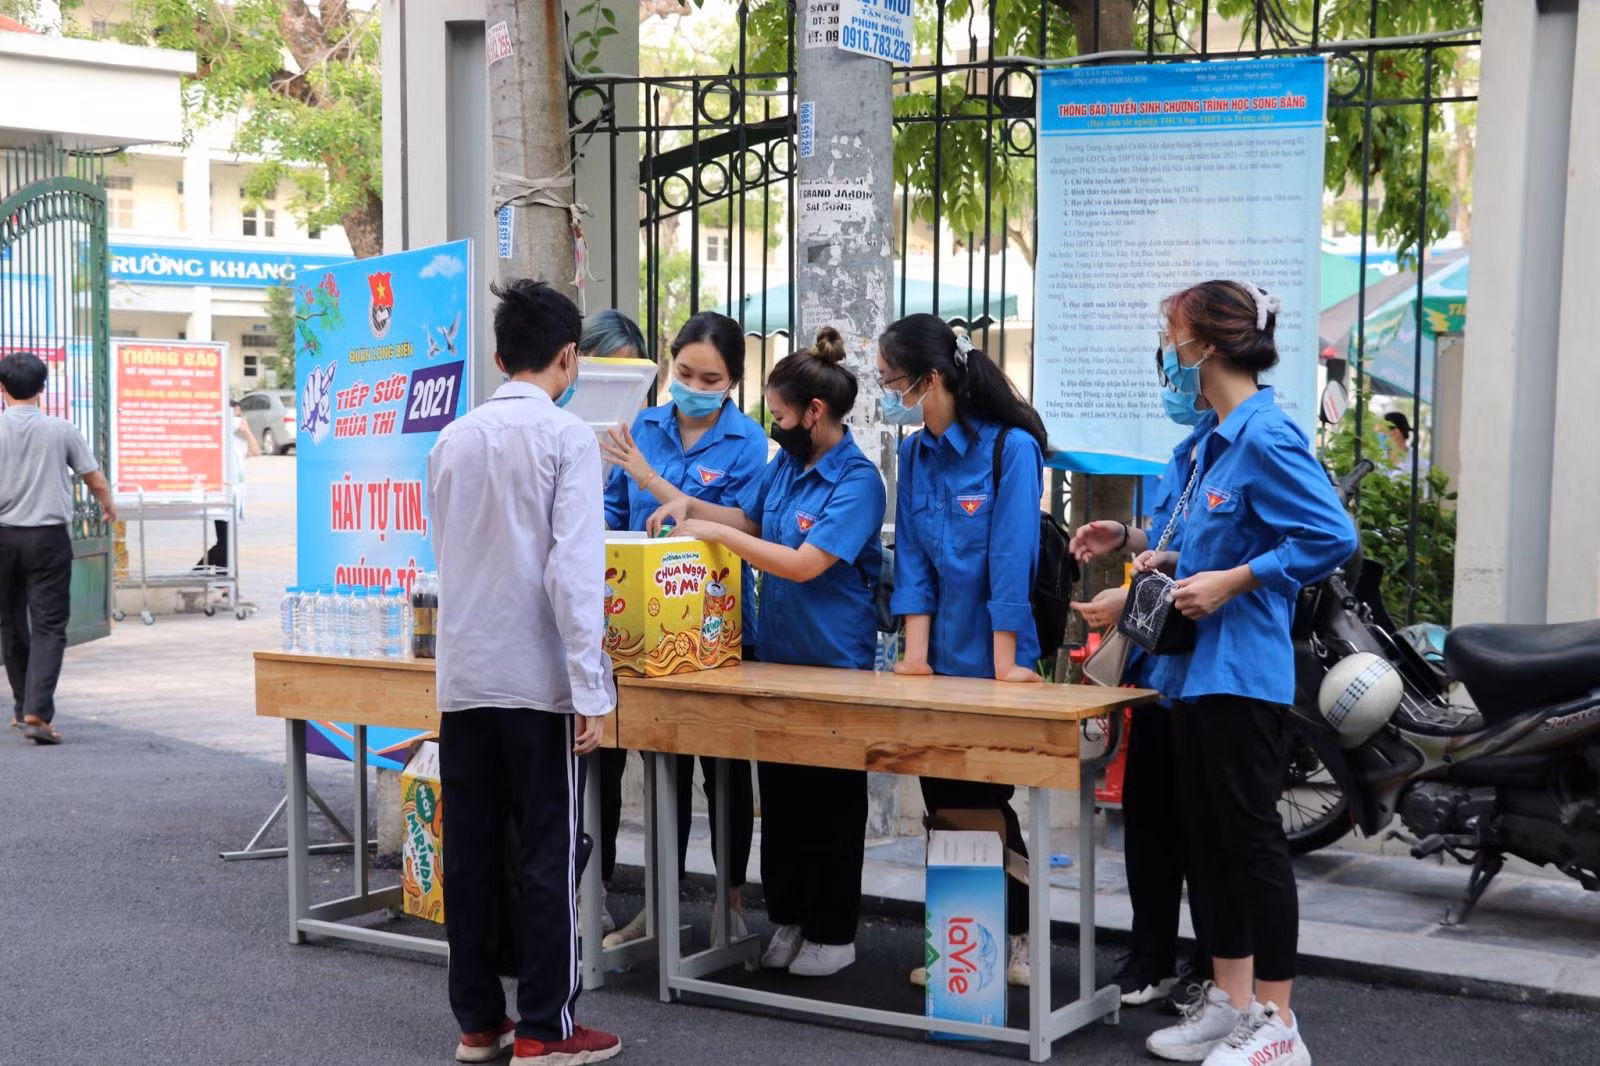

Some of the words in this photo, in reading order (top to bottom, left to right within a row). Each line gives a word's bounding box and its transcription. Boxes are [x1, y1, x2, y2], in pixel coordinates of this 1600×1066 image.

[851, 16, 879, 31] PHUN
[842, 24, 911, 63] 0916.783.226
[1059, 102, 1087, 117] THÔNG
[1089, 100, 1107, 116] BÁO
[1109, 96, 1137, 115] TUYỂN
[1139, 101, 1161, 114] SINH
[1163, 99, 1200, 114] CHƯƠNG
[1202, 96, 1229, 112] TRÌNH
[1231, 98, 1250, 114] HỌC
[1252, 97, 1278, 110] SONG
[112, 252, 204, 277] RƯỜNG
[210, 260, 296, 280] KHANG
[123, 349, 179, 366] THÔNG
[184, 350, 218, 368] BÁO
[373, 345, 394, 362] LONG
[396, 338, 414, 359] BIÊN
[336, 380, 370, 411] TIẾP
[372, 372, 408, 405] SỨC
[408, 374, 456, 420] 2021
[335, 411, 367, 438] MÙA
[372, 410, 397, 435] THI
[332, 474, 364, 532] HÃY
[368, 477, 391, 542] TỰ
[393, 480, 428, 538] TIN,
[656, 566, 681, 584] CHUA
